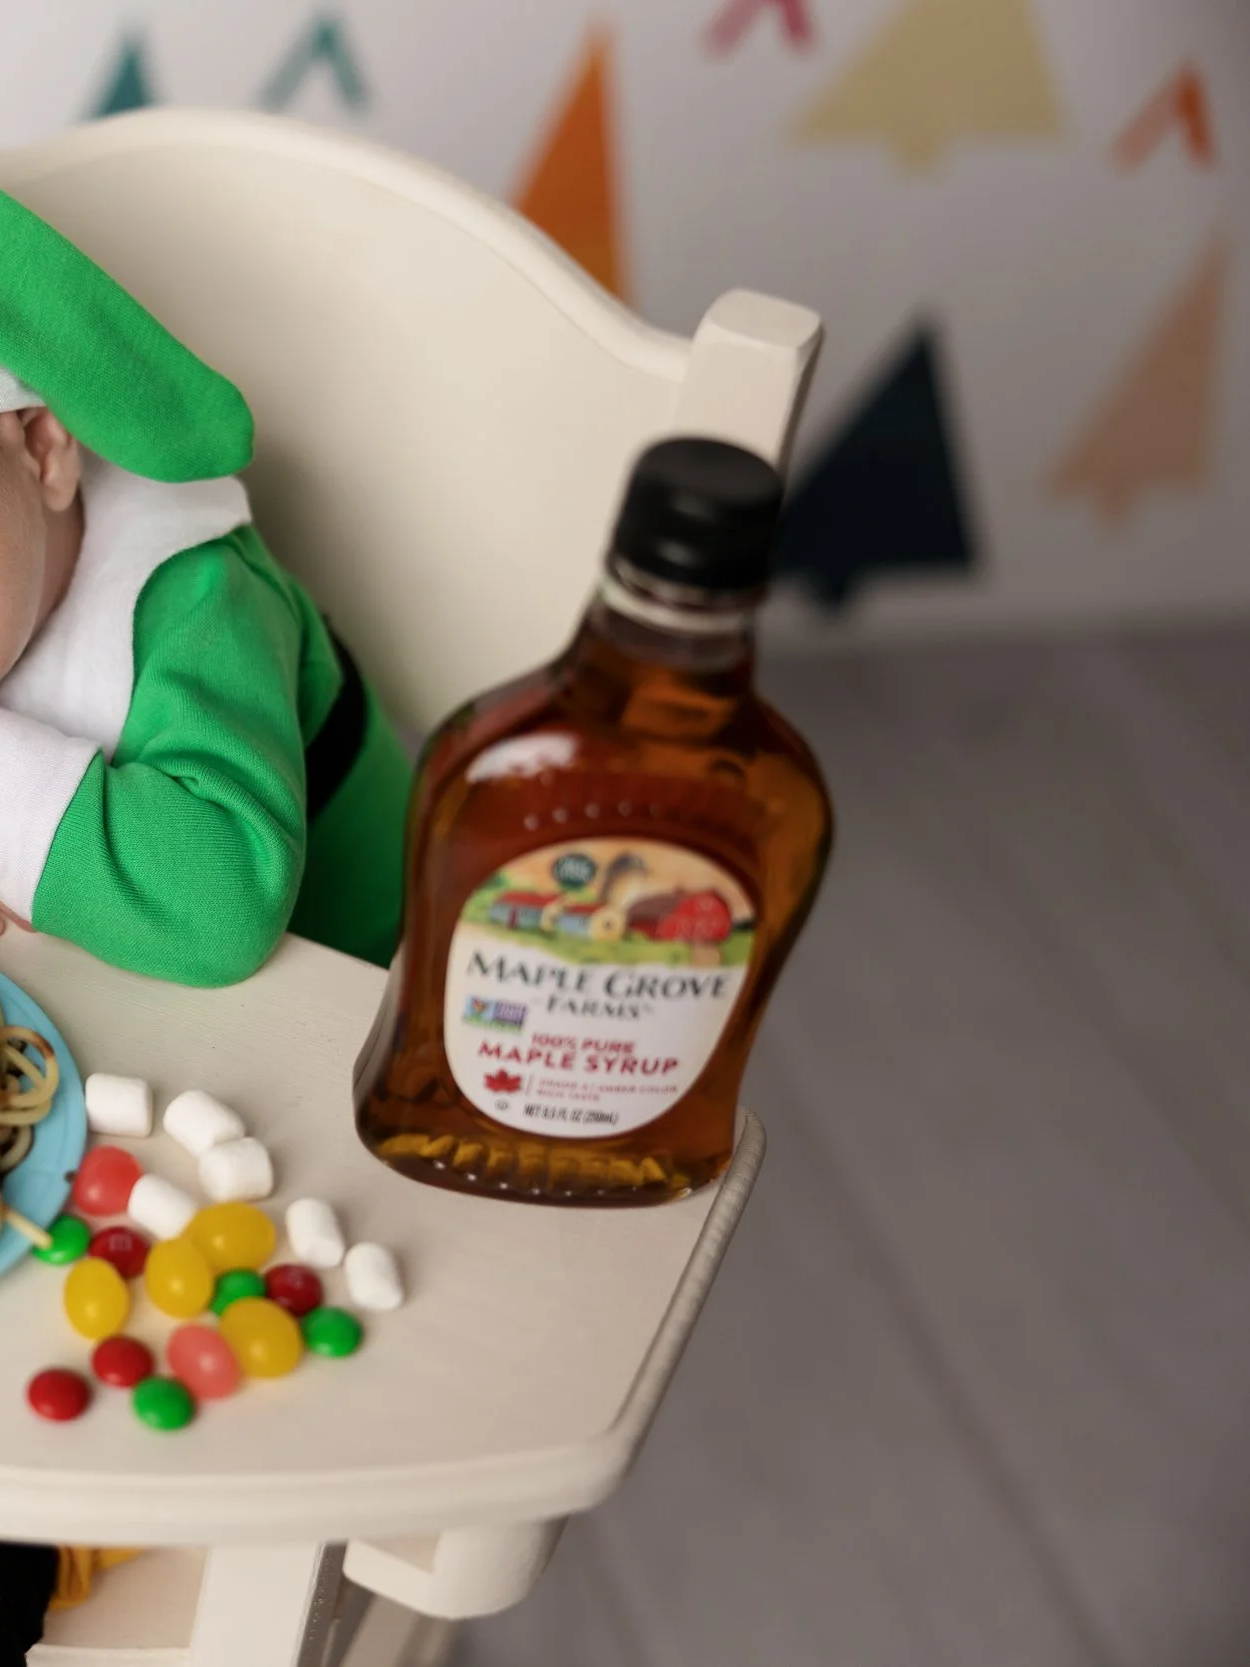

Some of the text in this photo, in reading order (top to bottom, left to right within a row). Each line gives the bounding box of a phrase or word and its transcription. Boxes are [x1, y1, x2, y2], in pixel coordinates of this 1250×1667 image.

[466, 950, 731, 999] MAPLE GROVE
[546, 994, 640, 1020] FARMS
[478, 1039, 679, 1077] MAPLE SYRUP
[531, 1033, 635, 1054] 100% PURE
